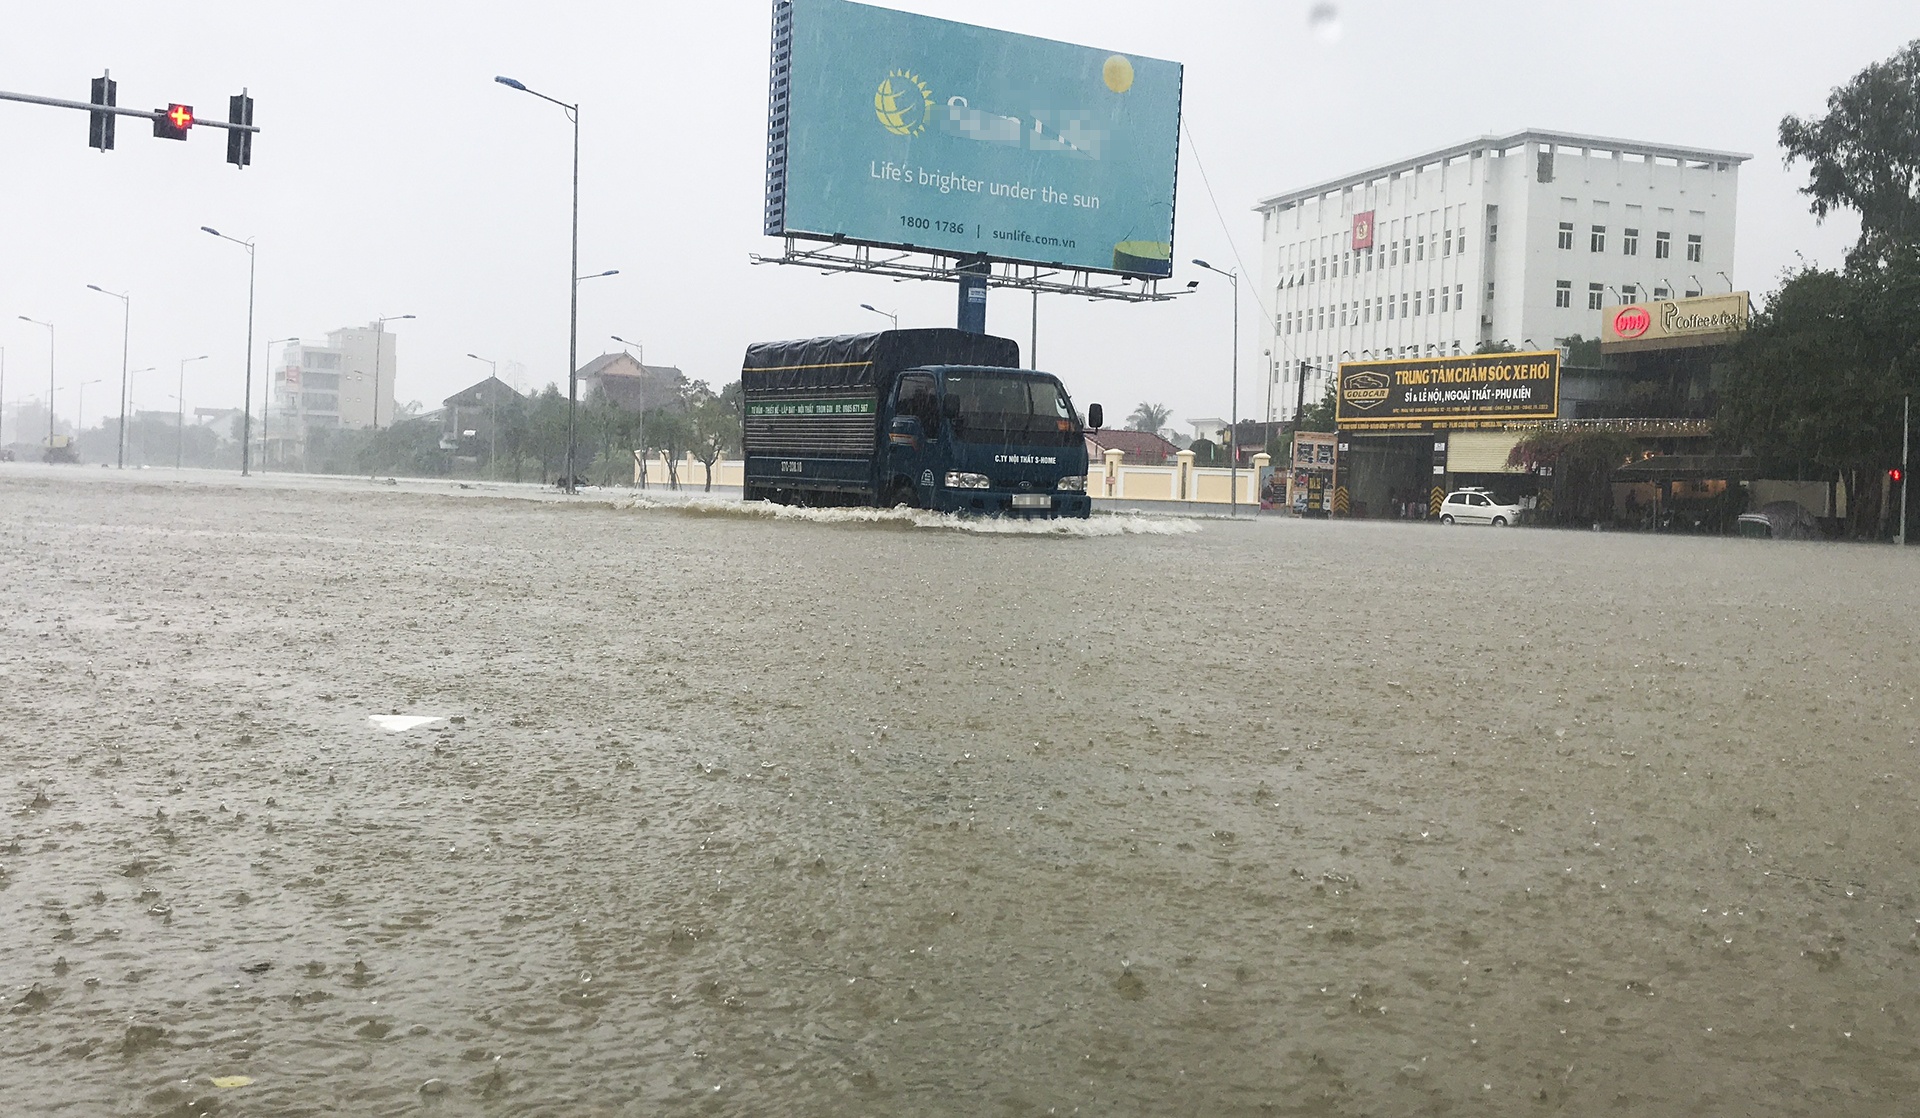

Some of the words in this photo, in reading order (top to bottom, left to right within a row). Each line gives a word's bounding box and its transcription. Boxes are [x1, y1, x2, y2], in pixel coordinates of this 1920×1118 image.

[870, 161, 912, 184] Life's
[918, 167, 984, 195] brighter
[989, 179, 1037, 202] under
[1041, 186, 1067, 207] the
[1073, 193, 1100, 210] sun
[900, 215, 930, 230] 1800
[934, 219, 964, 234] 1786
[992, 228, 1076, 249] sunlife.com.vn
[1677, 314, 1711, 328] Coffee
[1711, 314, 1719, 325] &
[1395, 369, 1429, 384] TRUNG
[1488, 361, 1511, 381] SÓC
[1513, 364, 1528, 380] XE
[1529, 361, 1550, 379] HƠI
[1472, 384, 1491, 400] THẤT
[1495, 388, 1511, 402] PHỤ
[1513, 385, 1531, 401] KIỆN
